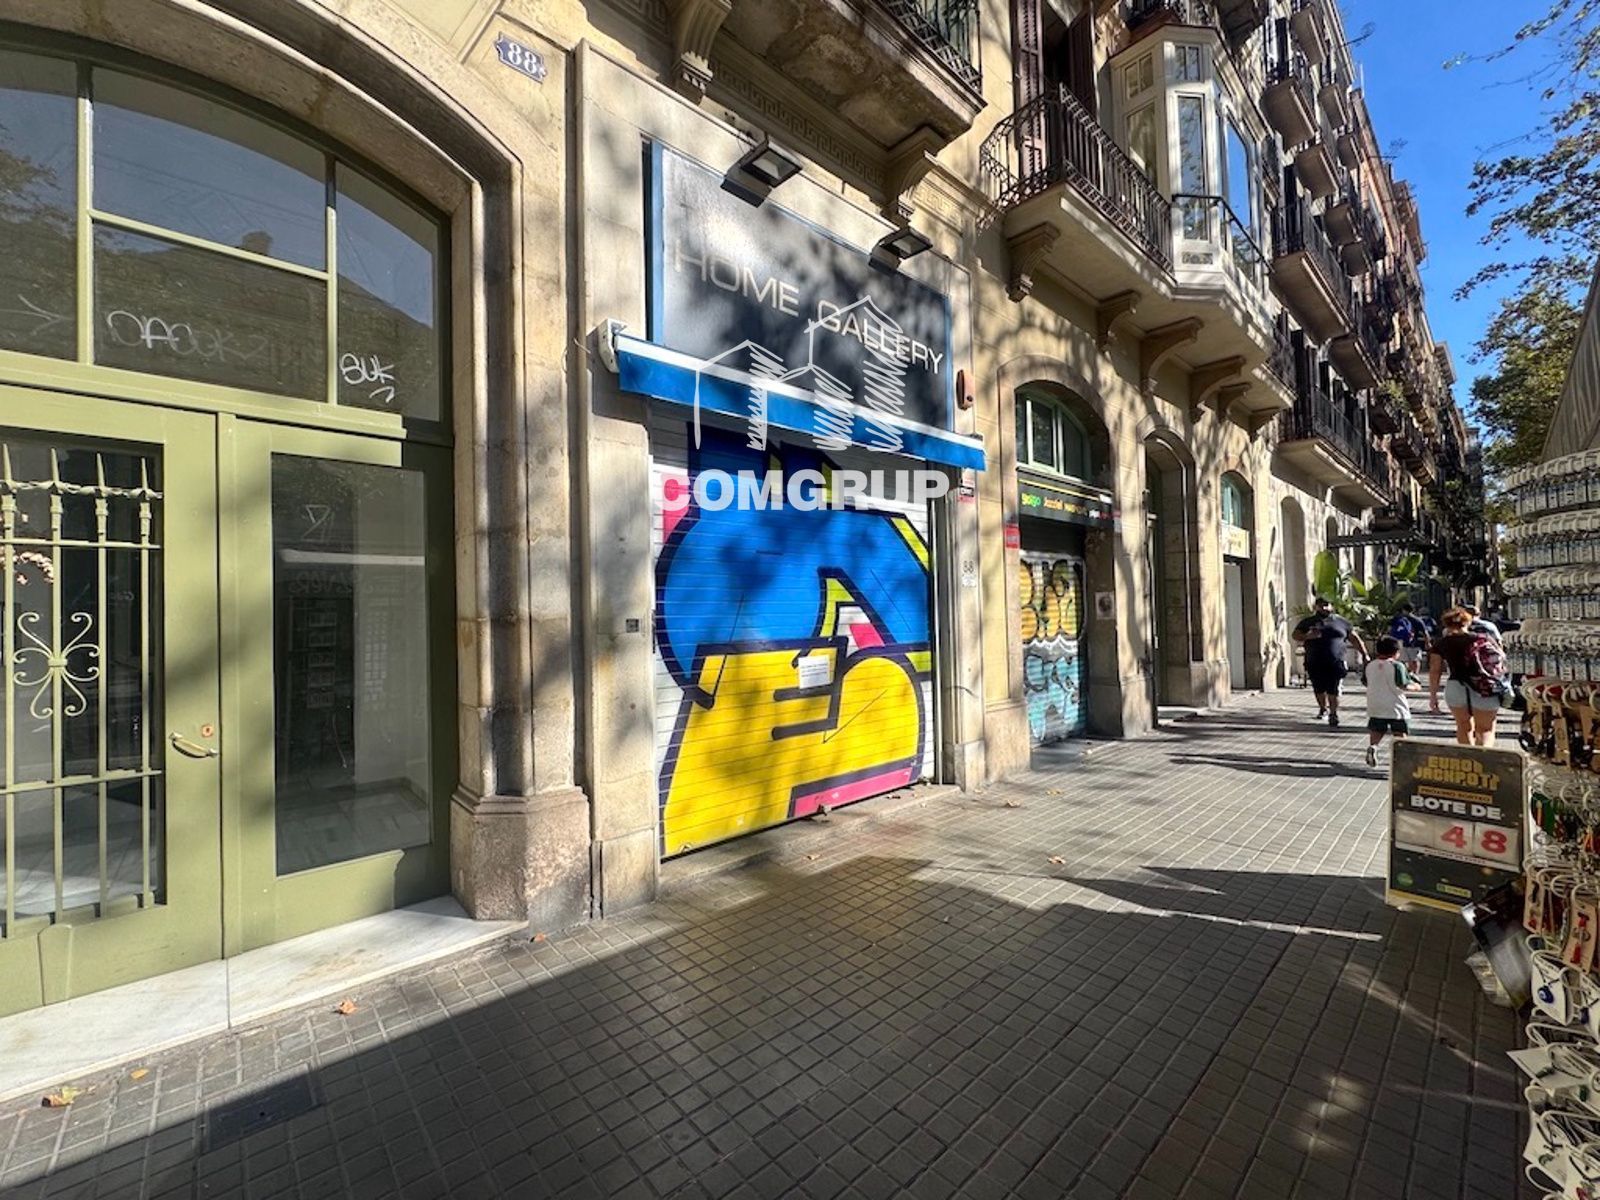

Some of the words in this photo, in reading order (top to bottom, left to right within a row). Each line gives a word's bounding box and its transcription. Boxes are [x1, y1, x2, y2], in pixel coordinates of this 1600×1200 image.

[508, 43, 537, 74] 88
[675, 239, 800, 317] HOME
[817, 300, 944, 375] GALLERY
[1410, 794, 1467, 815] BOTE
[1471, 803, 1501, 820] DE
